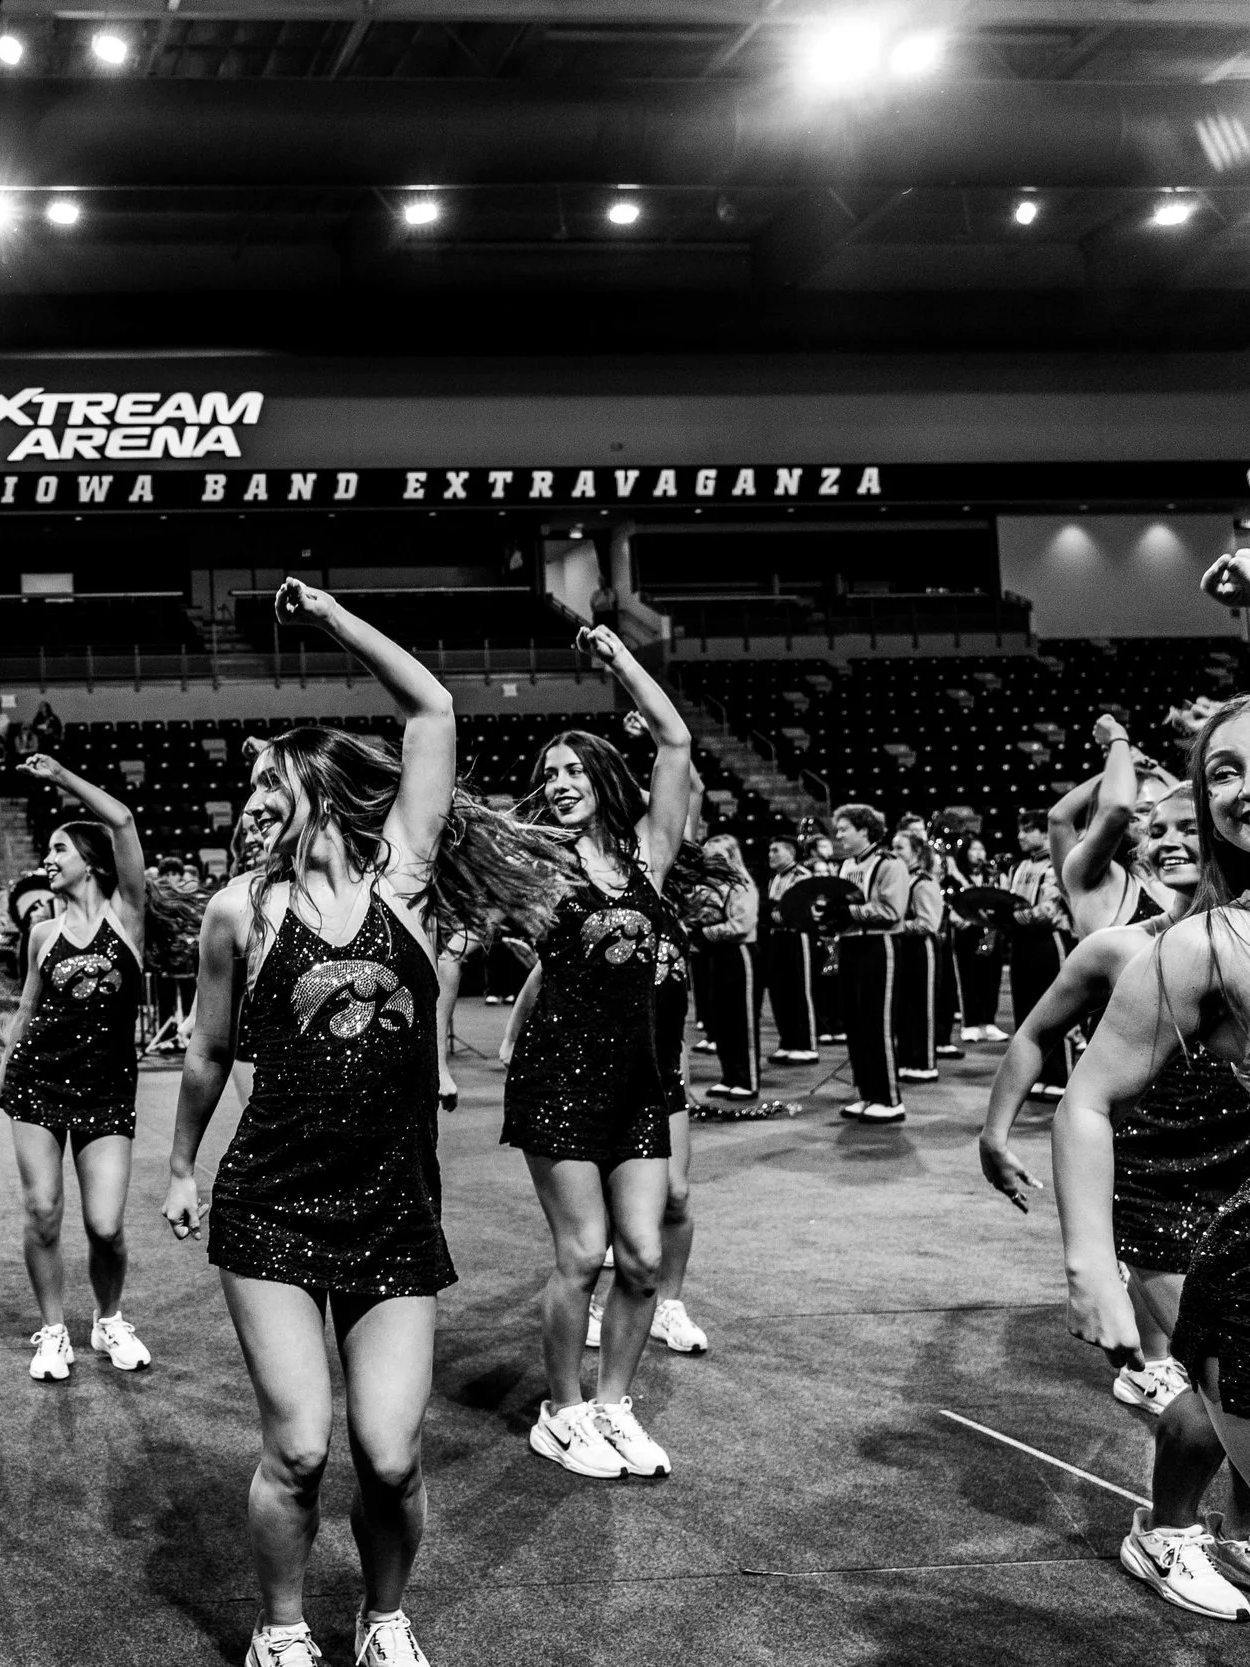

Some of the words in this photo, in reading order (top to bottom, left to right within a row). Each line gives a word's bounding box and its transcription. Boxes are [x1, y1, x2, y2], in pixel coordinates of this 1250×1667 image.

[7, 426, 242, 462] ARENA
[0, 475, 154, 504] IOWA
[202, 472, 358, 502] BAND
[403, 467, 881, 499] EXTRAVAGANZA
